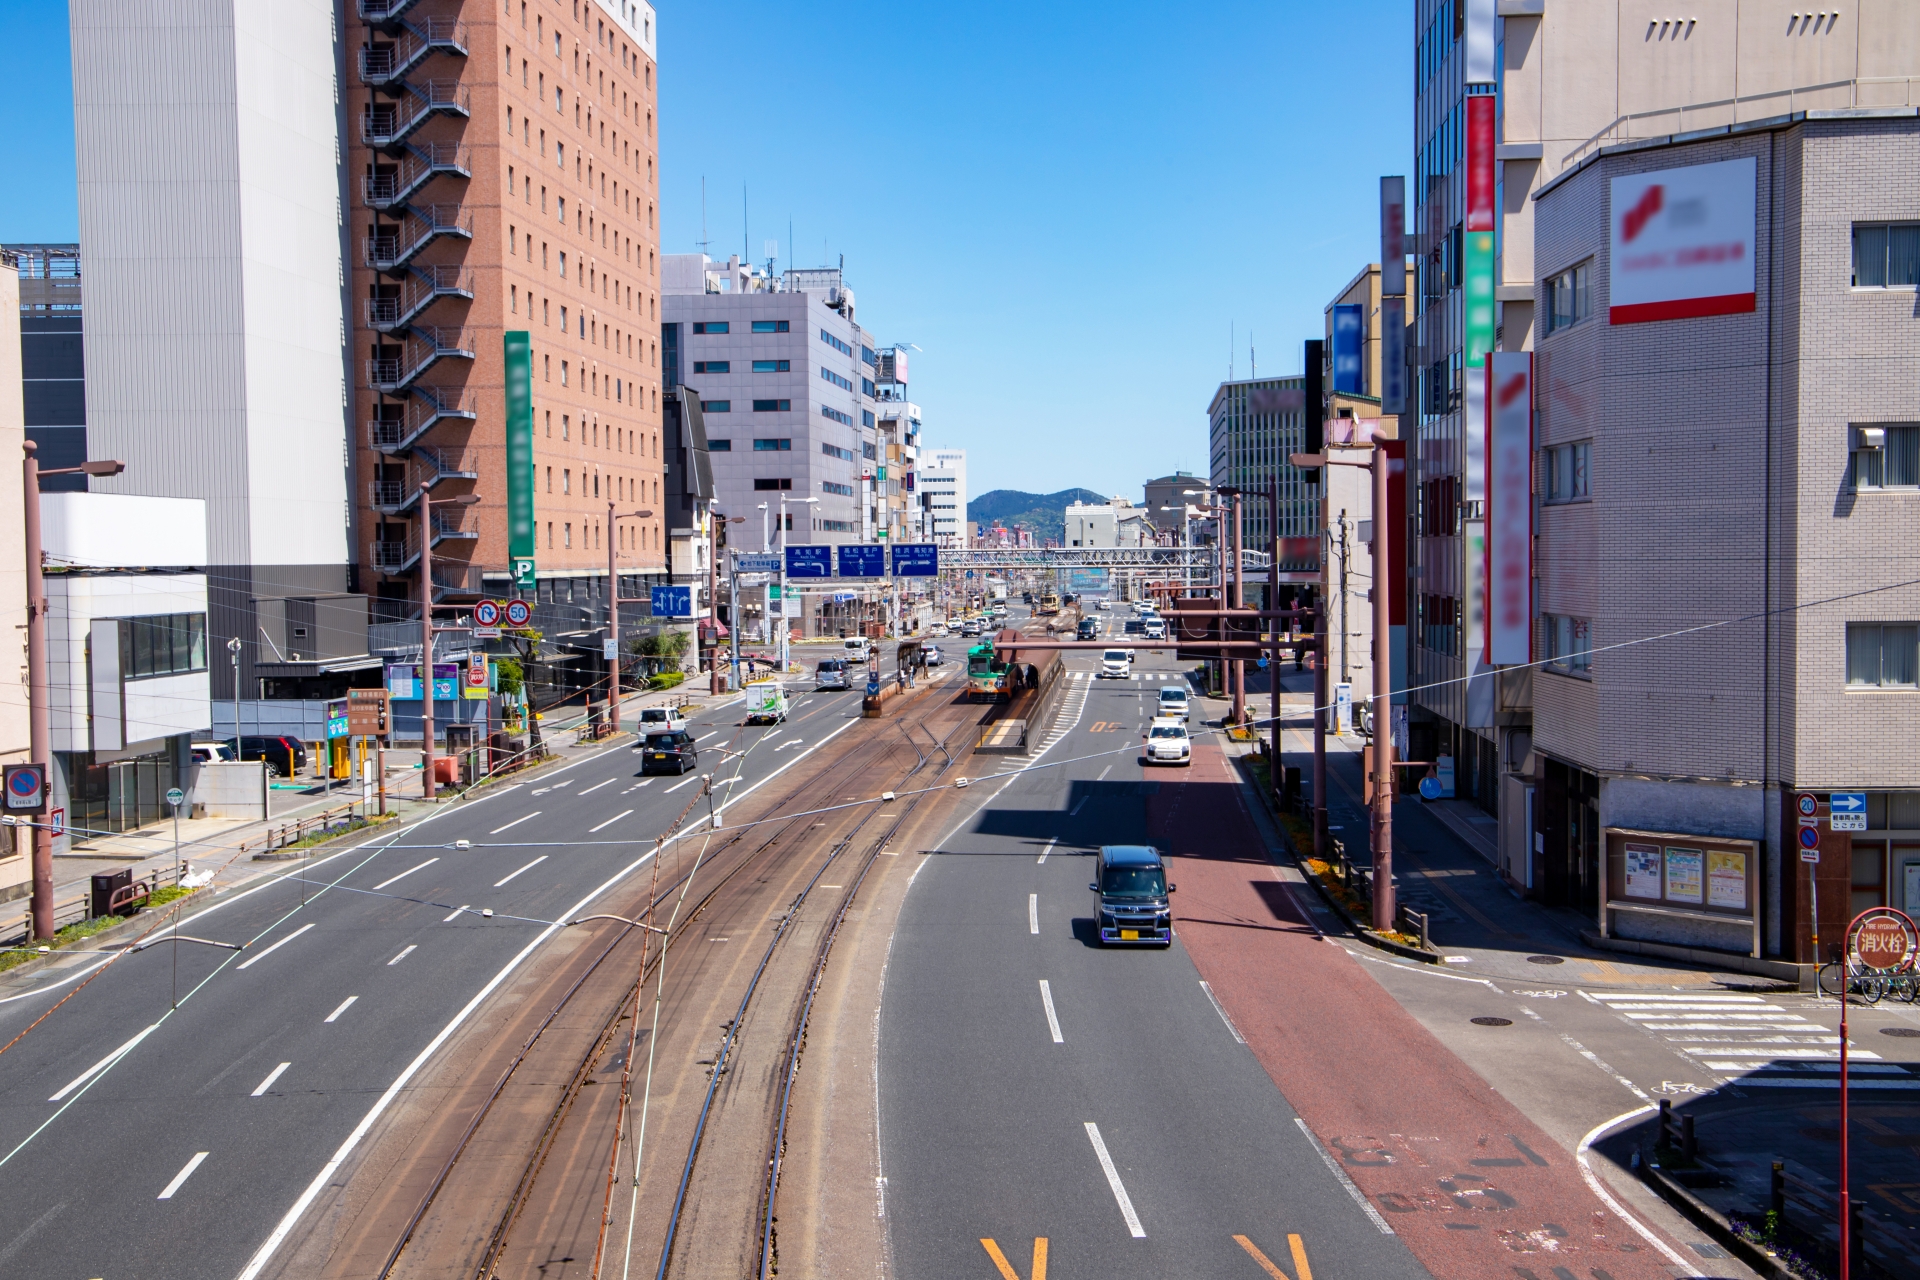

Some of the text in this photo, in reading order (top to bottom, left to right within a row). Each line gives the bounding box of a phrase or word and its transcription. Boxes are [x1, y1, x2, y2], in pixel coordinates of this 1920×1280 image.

[517, 561, 533, 577] P
[510, 606, 526, 619] 50
[1801, 799, 1813, 811] 20
[1861, 932, 1904, 953] 消火栓
